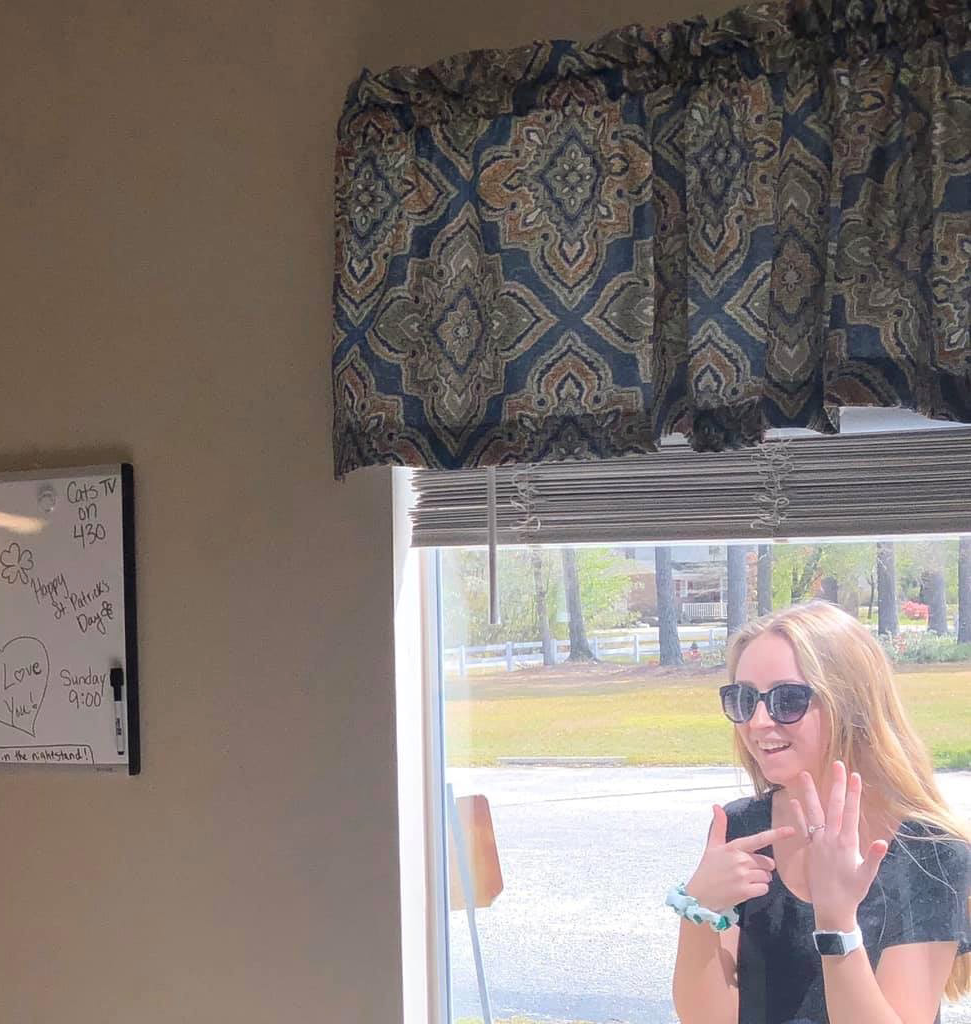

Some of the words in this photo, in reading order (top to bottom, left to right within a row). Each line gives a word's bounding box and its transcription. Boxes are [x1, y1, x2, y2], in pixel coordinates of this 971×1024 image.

[67, 481, 99, 504] Cats
[99, 477, 117, 496] TV
[78, 503, 97, 521] on
[74, 523, 106, 549] 430
[30, 573, 70, 604] Happy
[60, 665, 106, 697] Sunday
[69, 689, 101, 709] 9:00
[15, 749, 28, 761] the
